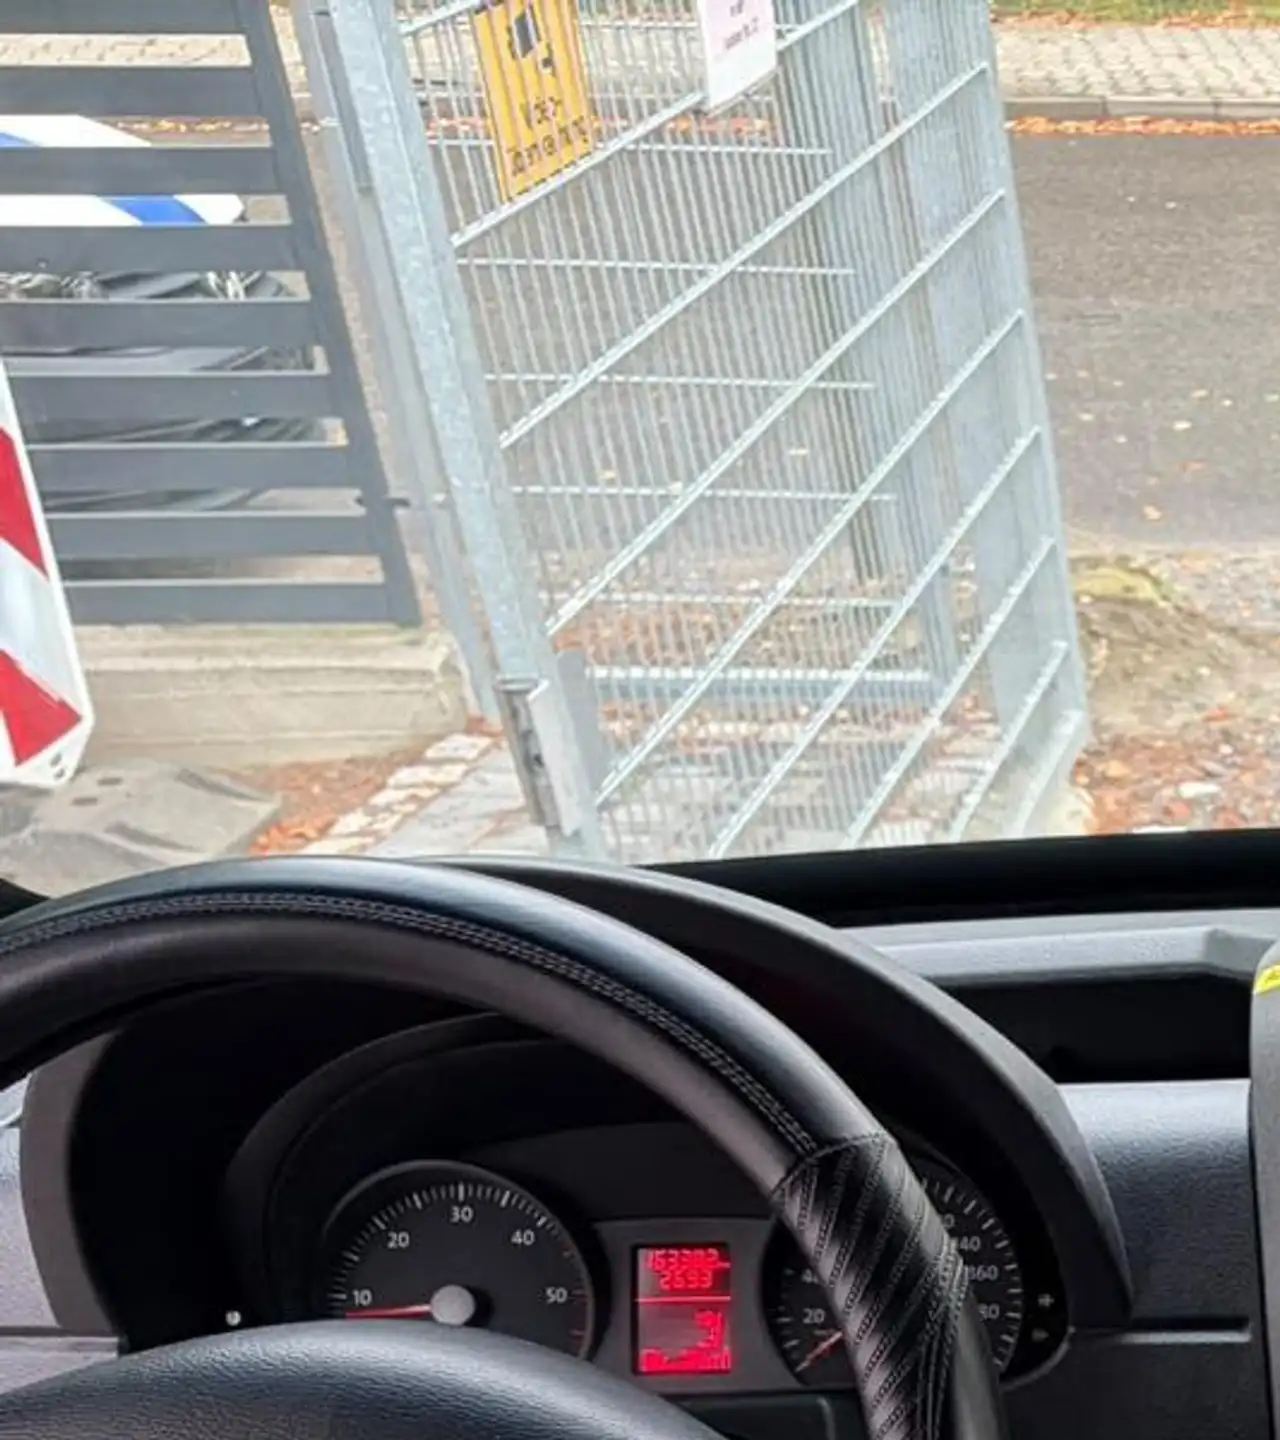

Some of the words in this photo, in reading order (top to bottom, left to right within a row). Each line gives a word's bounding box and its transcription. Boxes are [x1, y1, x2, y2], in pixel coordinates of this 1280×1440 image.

[450, 1206, 474, 1224] 30
[387, 1231, 410, 1249] 20
[511, 1229, 535, 1246] 40
[352, 1289, 373, 1306] 10
[546, 1286, 568, 1304] 50
[802, 1308, 826, 1325] 20
